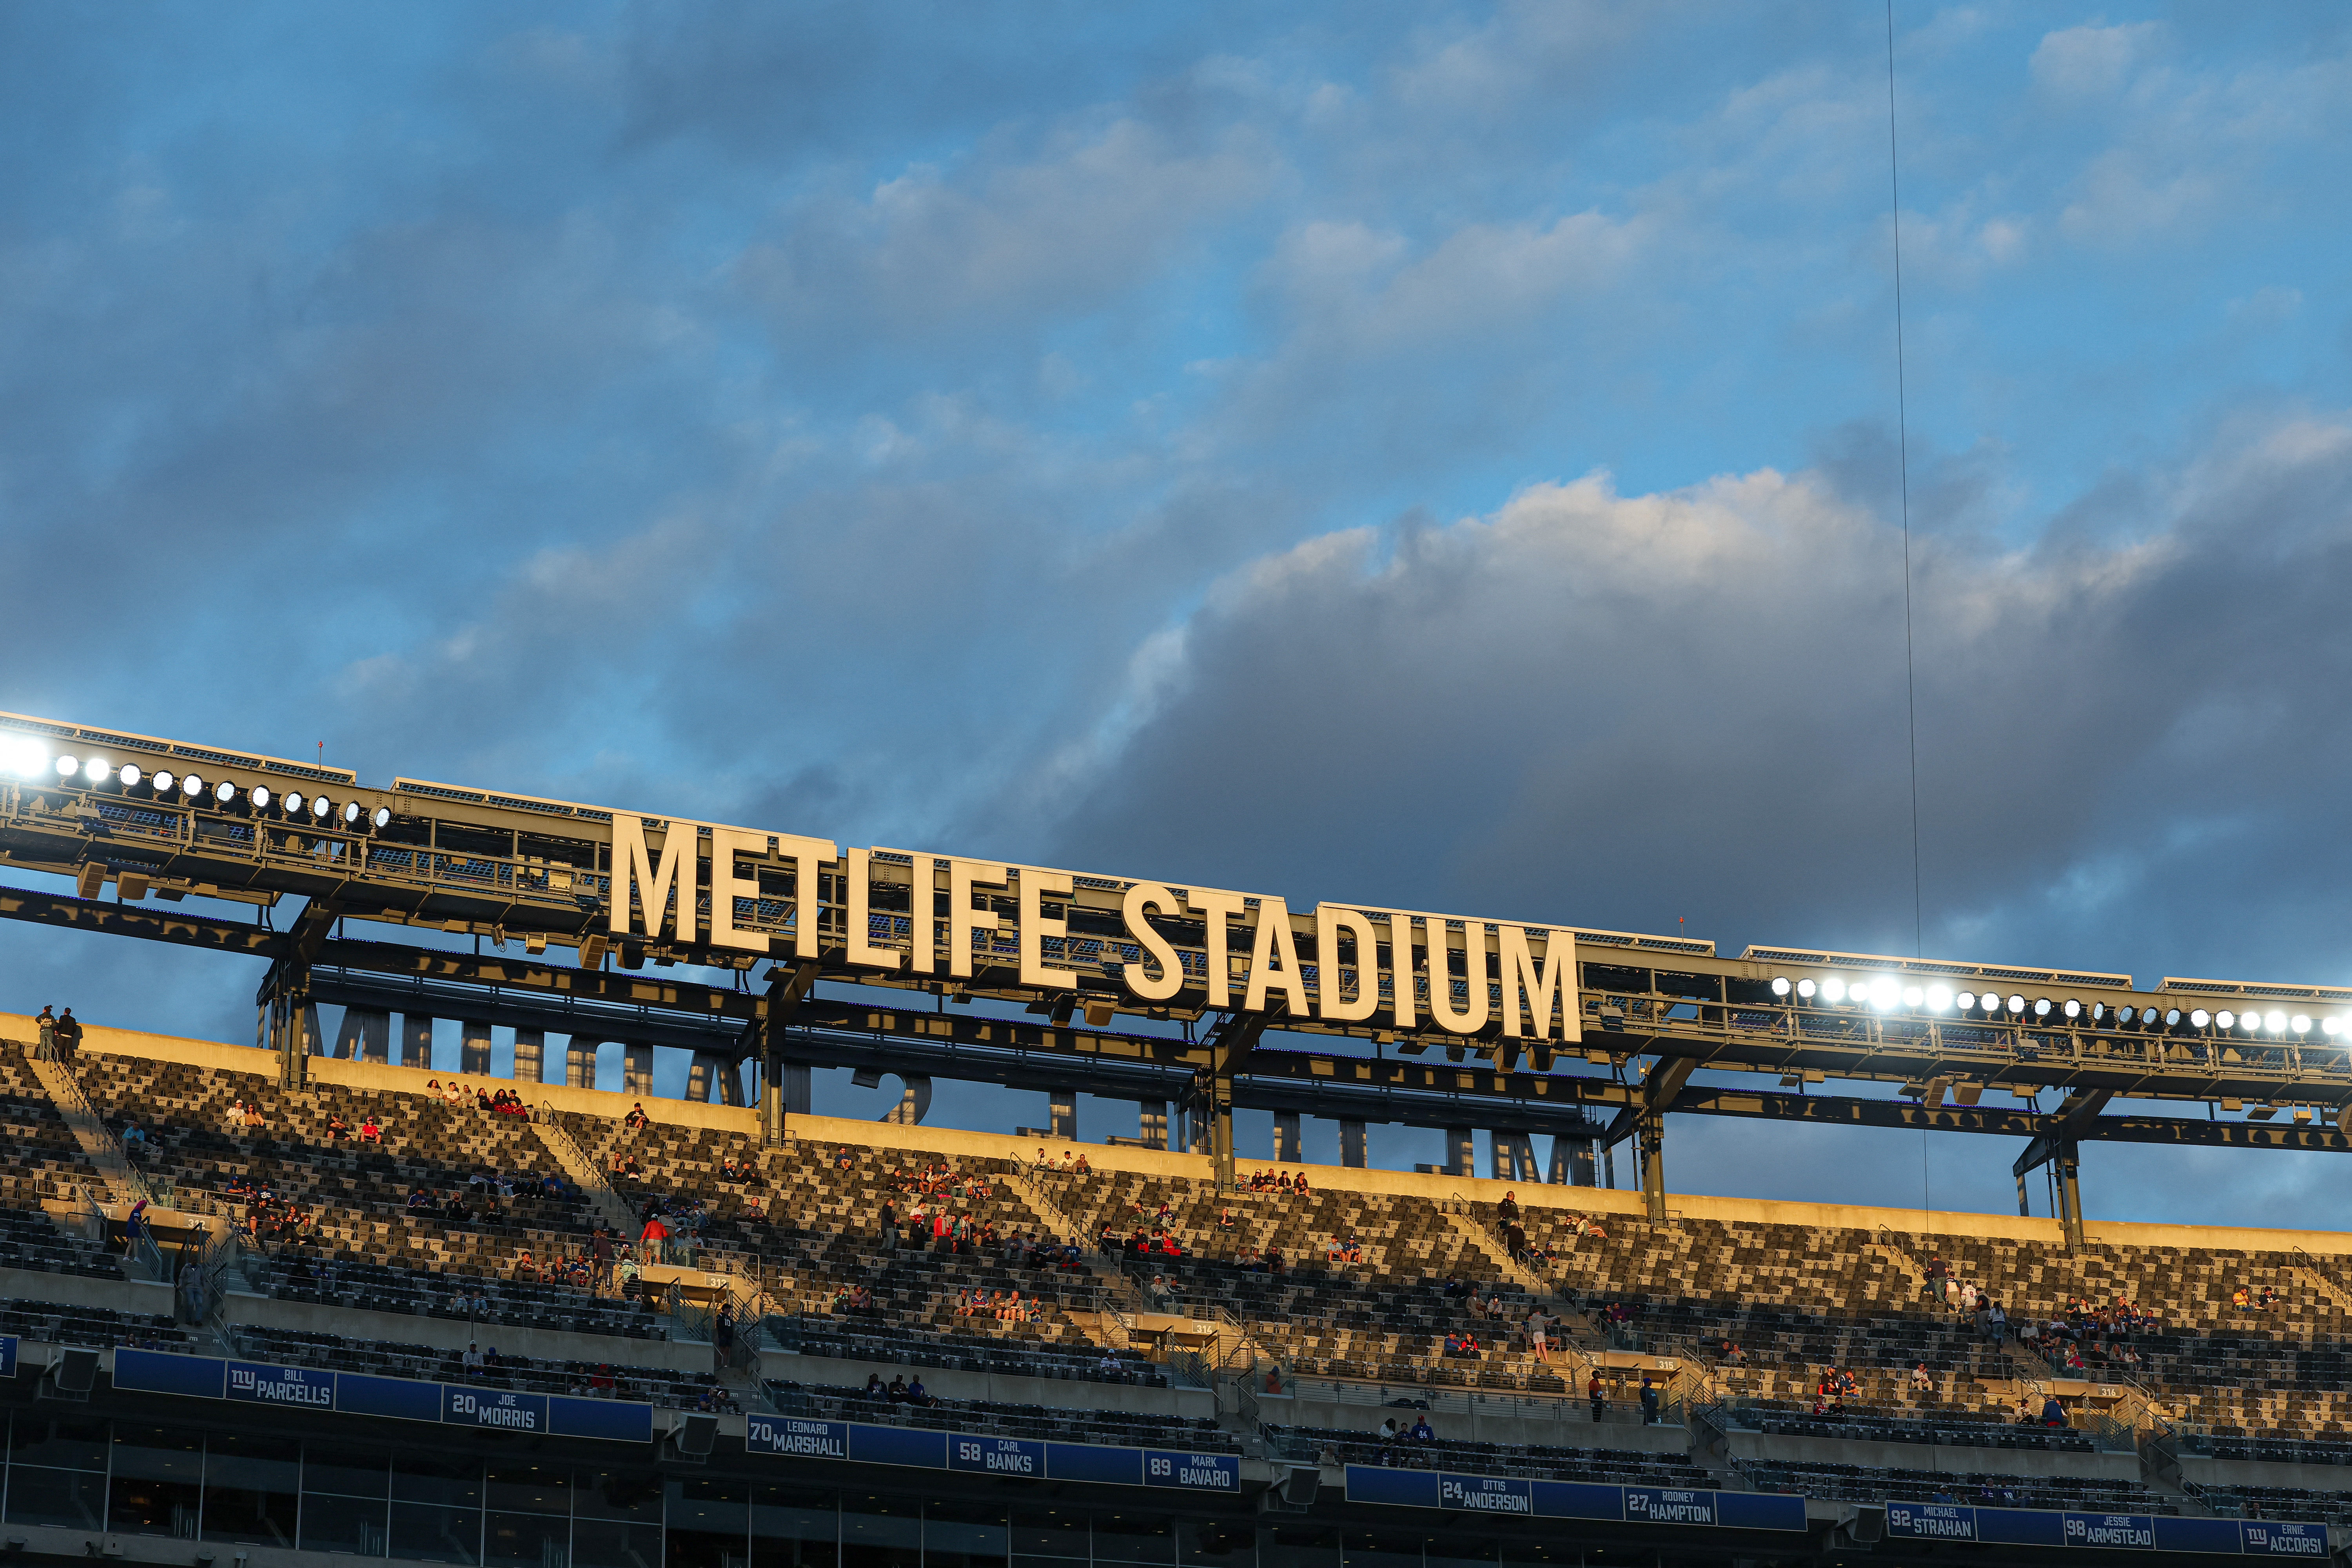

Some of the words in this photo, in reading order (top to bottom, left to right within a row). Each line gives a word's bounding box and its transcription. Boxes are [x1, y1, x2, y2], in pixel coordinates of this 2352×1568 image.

[609, 813, 1078, 989] METLIFE
[1122, 883, 1583, 1042] STADIUM
[724, 1318, 731, 1327] 10
[1196, 1325, 1212, 1334] 314
[1659, 1360, 1674, 1369] 315
[284, 1369, 305, 1382] BILL
[257, 1380, 330, 1405] PARCELLS
[498, 1394, 516, 1406] JOE
[2102, 1388, 2116, 1396] 316
[453, 1394, 475, 1414] 20
[478, 1406, 535, 1428] MORRIS
[750, 1423, 771, 1441] 70
[788, 1421, 828, 1435] LEONARD
[773, 1434, 844, 1457] MARSHALL
[960, 1442, 980, 1461] 58
[998, 1440, 1020, 1453] CARL
[986, 1452, 1032, 1472] BANKS
[1151, 1458, 1171, 1476] 89
[1192, 1455, 1218, 1468] MARK
[1180, 1468, 1230, 1487] BAVARO
[1483, 1480, 1506, 1491] OTTIS
[1443, 1481, 1463, 1499] 24
[1662, 1491, 1695, 1503] RODNEY
[1464, 1492, 1528, 1512] ANDERSON
[1629, 1494, 1648, 1511] 27
[1649, 1504, 1711, 1523] HAMPTON
[1891, 1510, 1911, 1526] 92
[1924, 1506, 1959, 1518] MICHAEL
[1914, 1518, 1971, 1537] STRAHAN
[2066, 1520, 2085, 1536] 98
[2104, 1515, 2131, 1527] JESSIE
[2282, 1524, 2305, 1535] ERNIE
[2087, 1527, 2151, 1545] ARMSTEAD
[2270, 1536, 2322, 1553] ACCORSI
